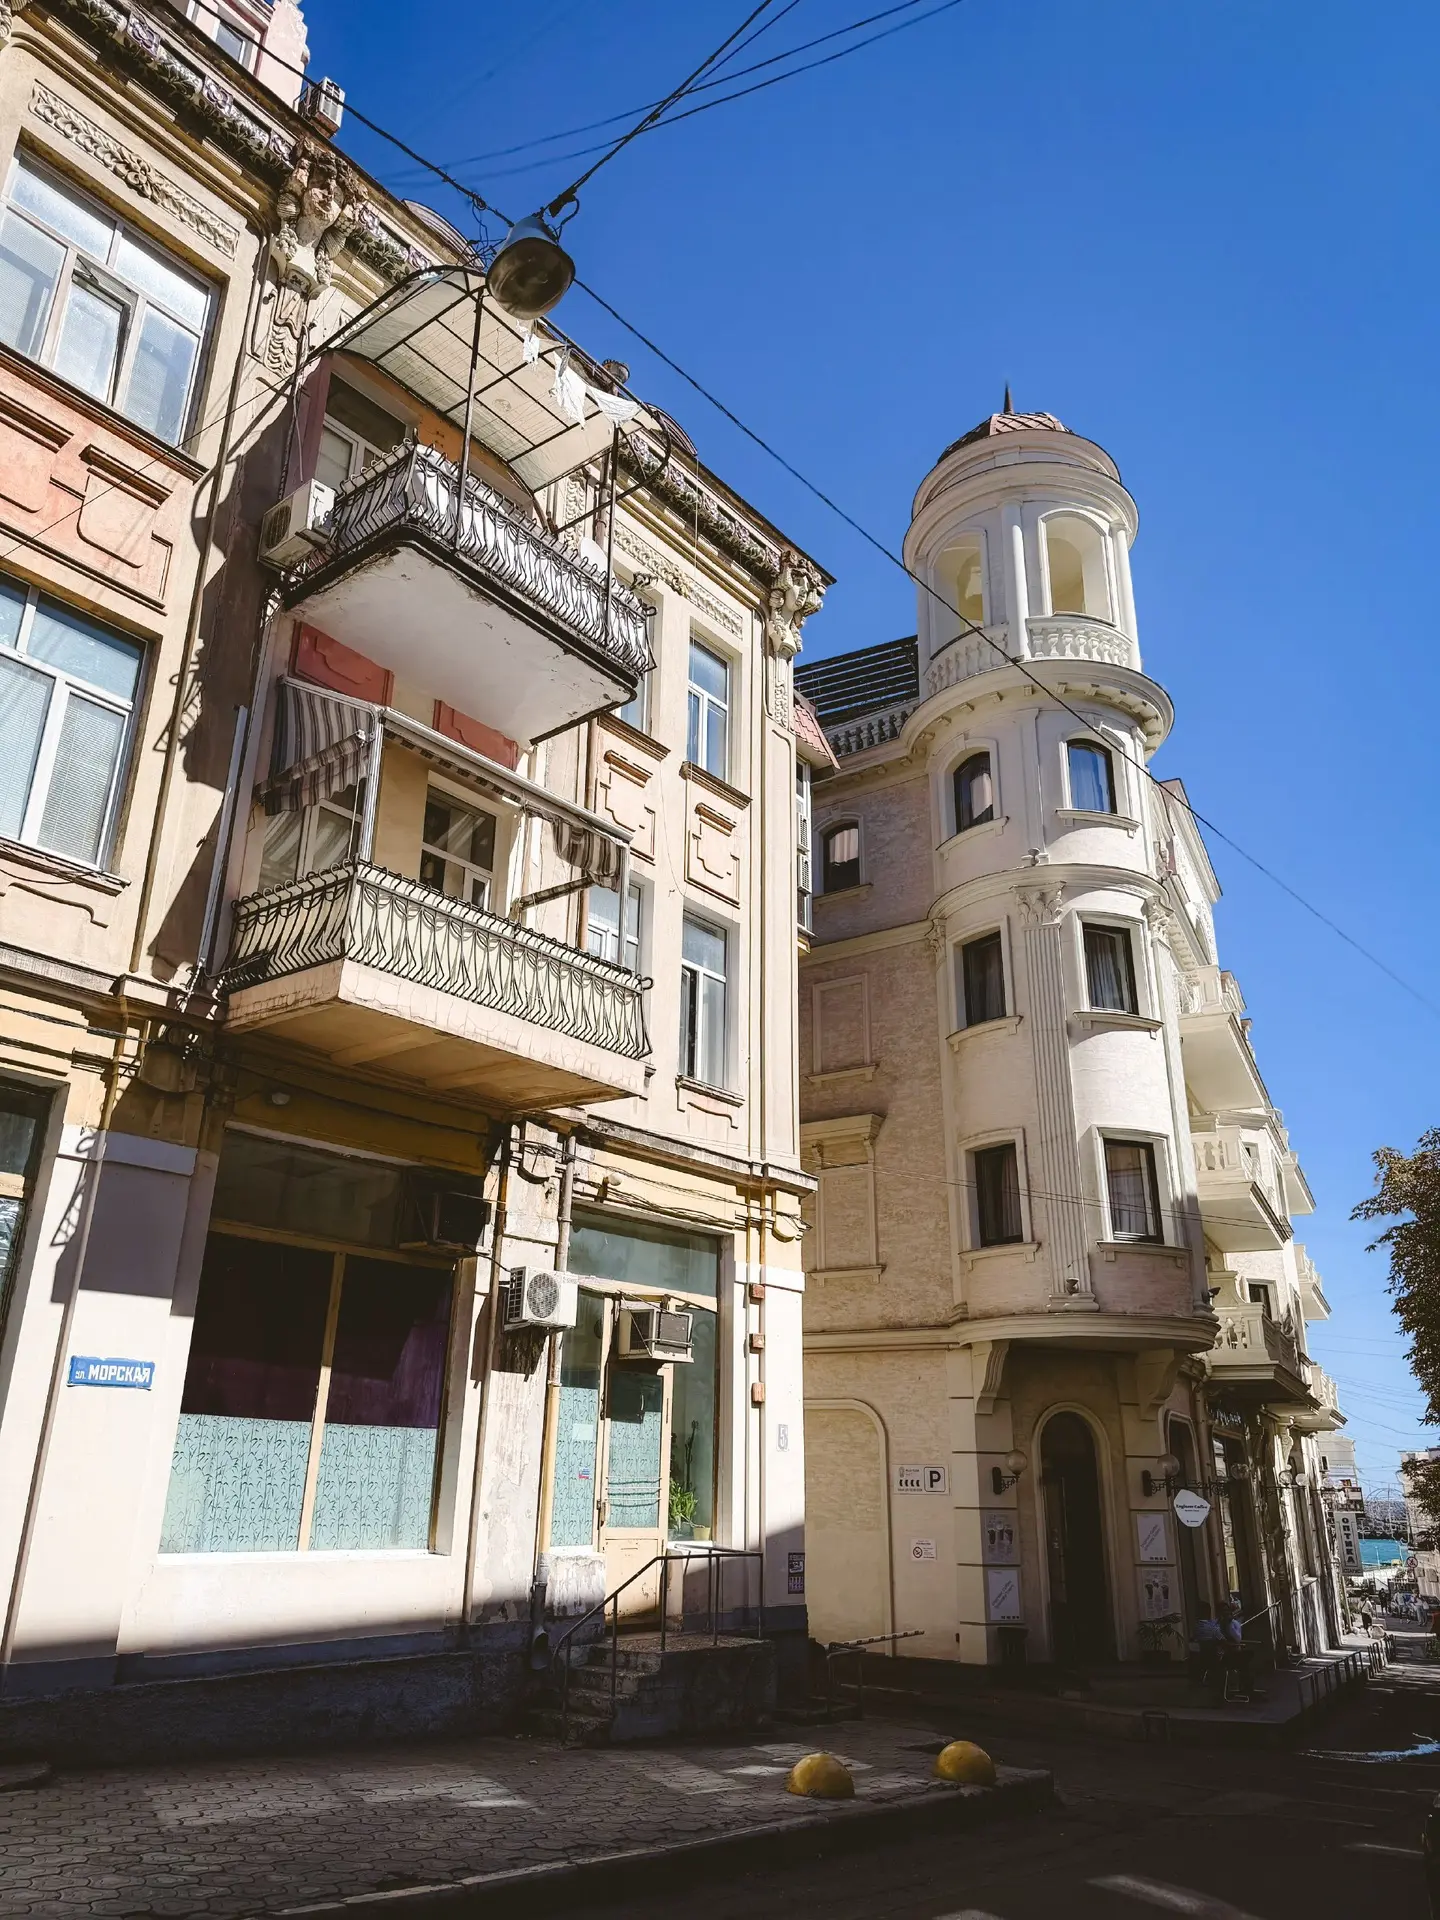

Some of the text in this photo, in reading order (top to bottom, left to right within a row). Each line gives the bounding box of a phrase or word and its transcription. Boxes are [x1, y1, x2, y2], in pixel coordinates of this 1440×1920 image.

[88, 1364, 151, 1383] МОРСКАЯ
[929, 1470, 941, 1488] P
[1342, 1517, 1355, 1564] ОПТИКА
